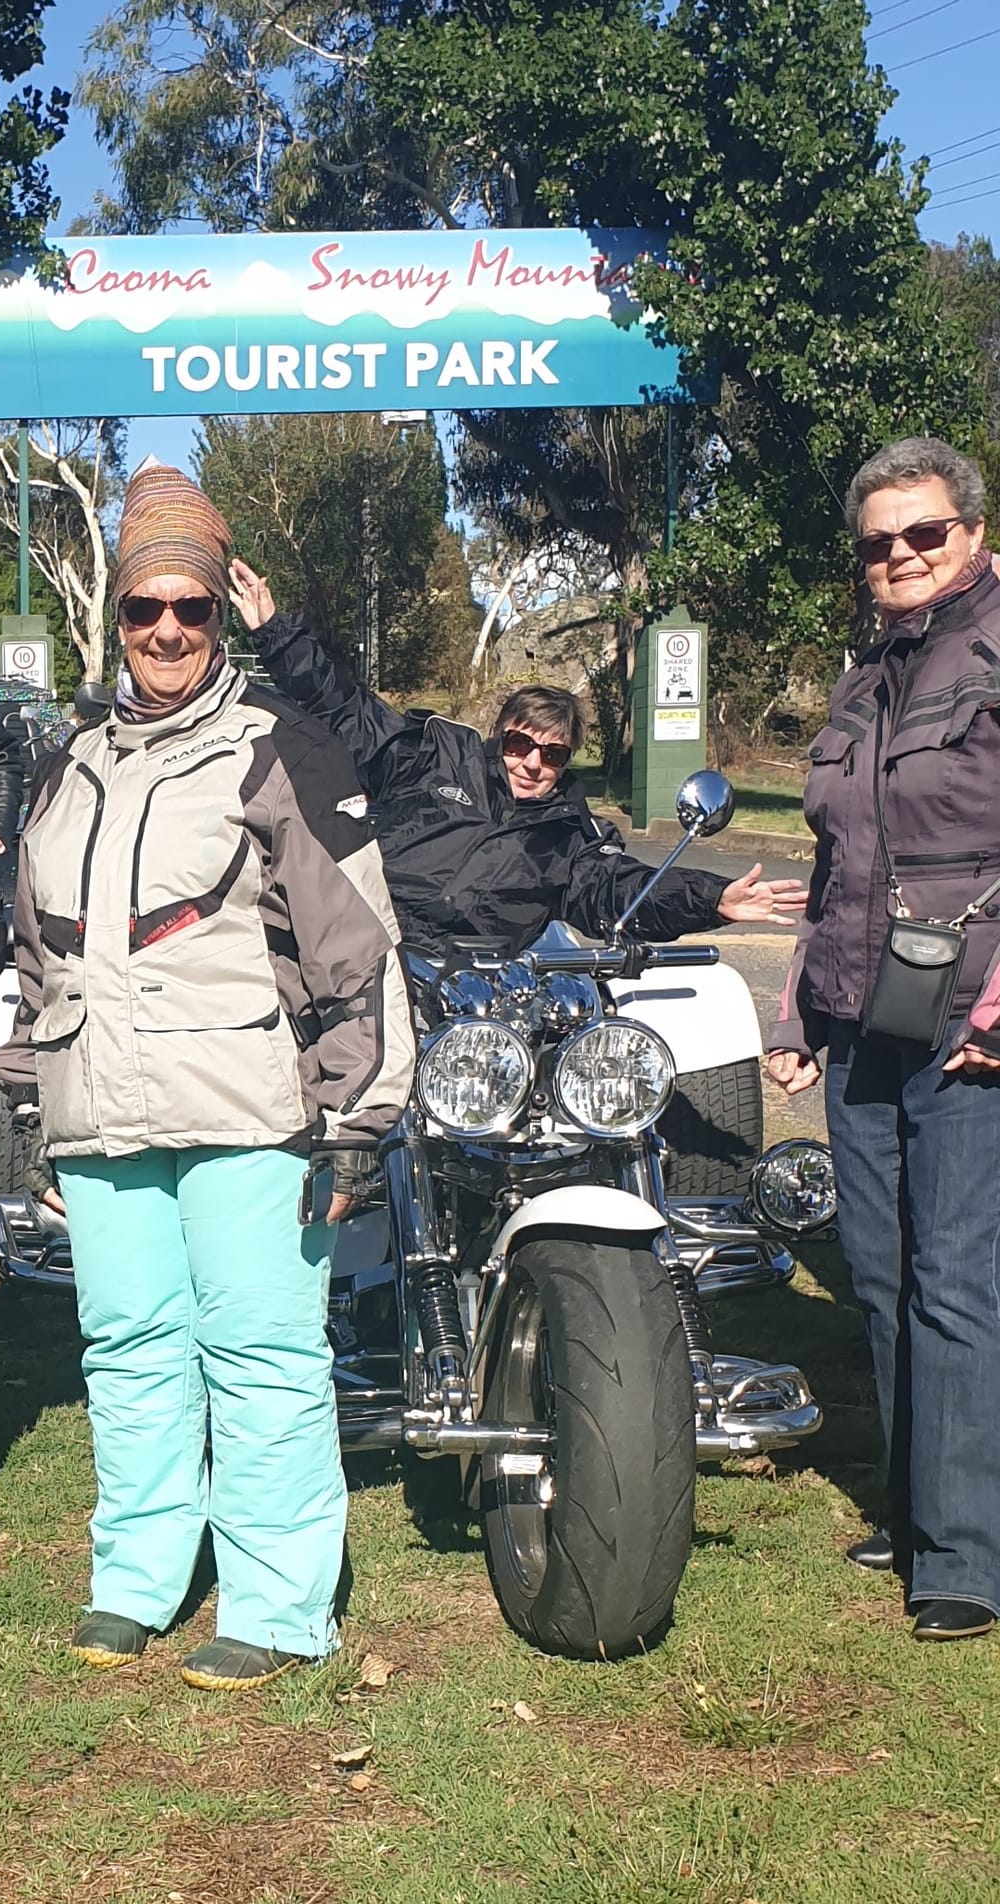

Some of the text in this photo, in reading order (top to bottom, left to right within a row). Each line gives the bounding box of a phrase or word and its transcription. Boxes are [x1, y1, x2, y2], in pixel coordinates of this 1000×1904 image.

[65, 248, 212, 295] Cooma
[307, 242, 451, 306] Snowy
[141, 339, 561, 392] TOURIST PARK
[19, 652, 31, 663] 10
[673, 640, 684, 651] 10
